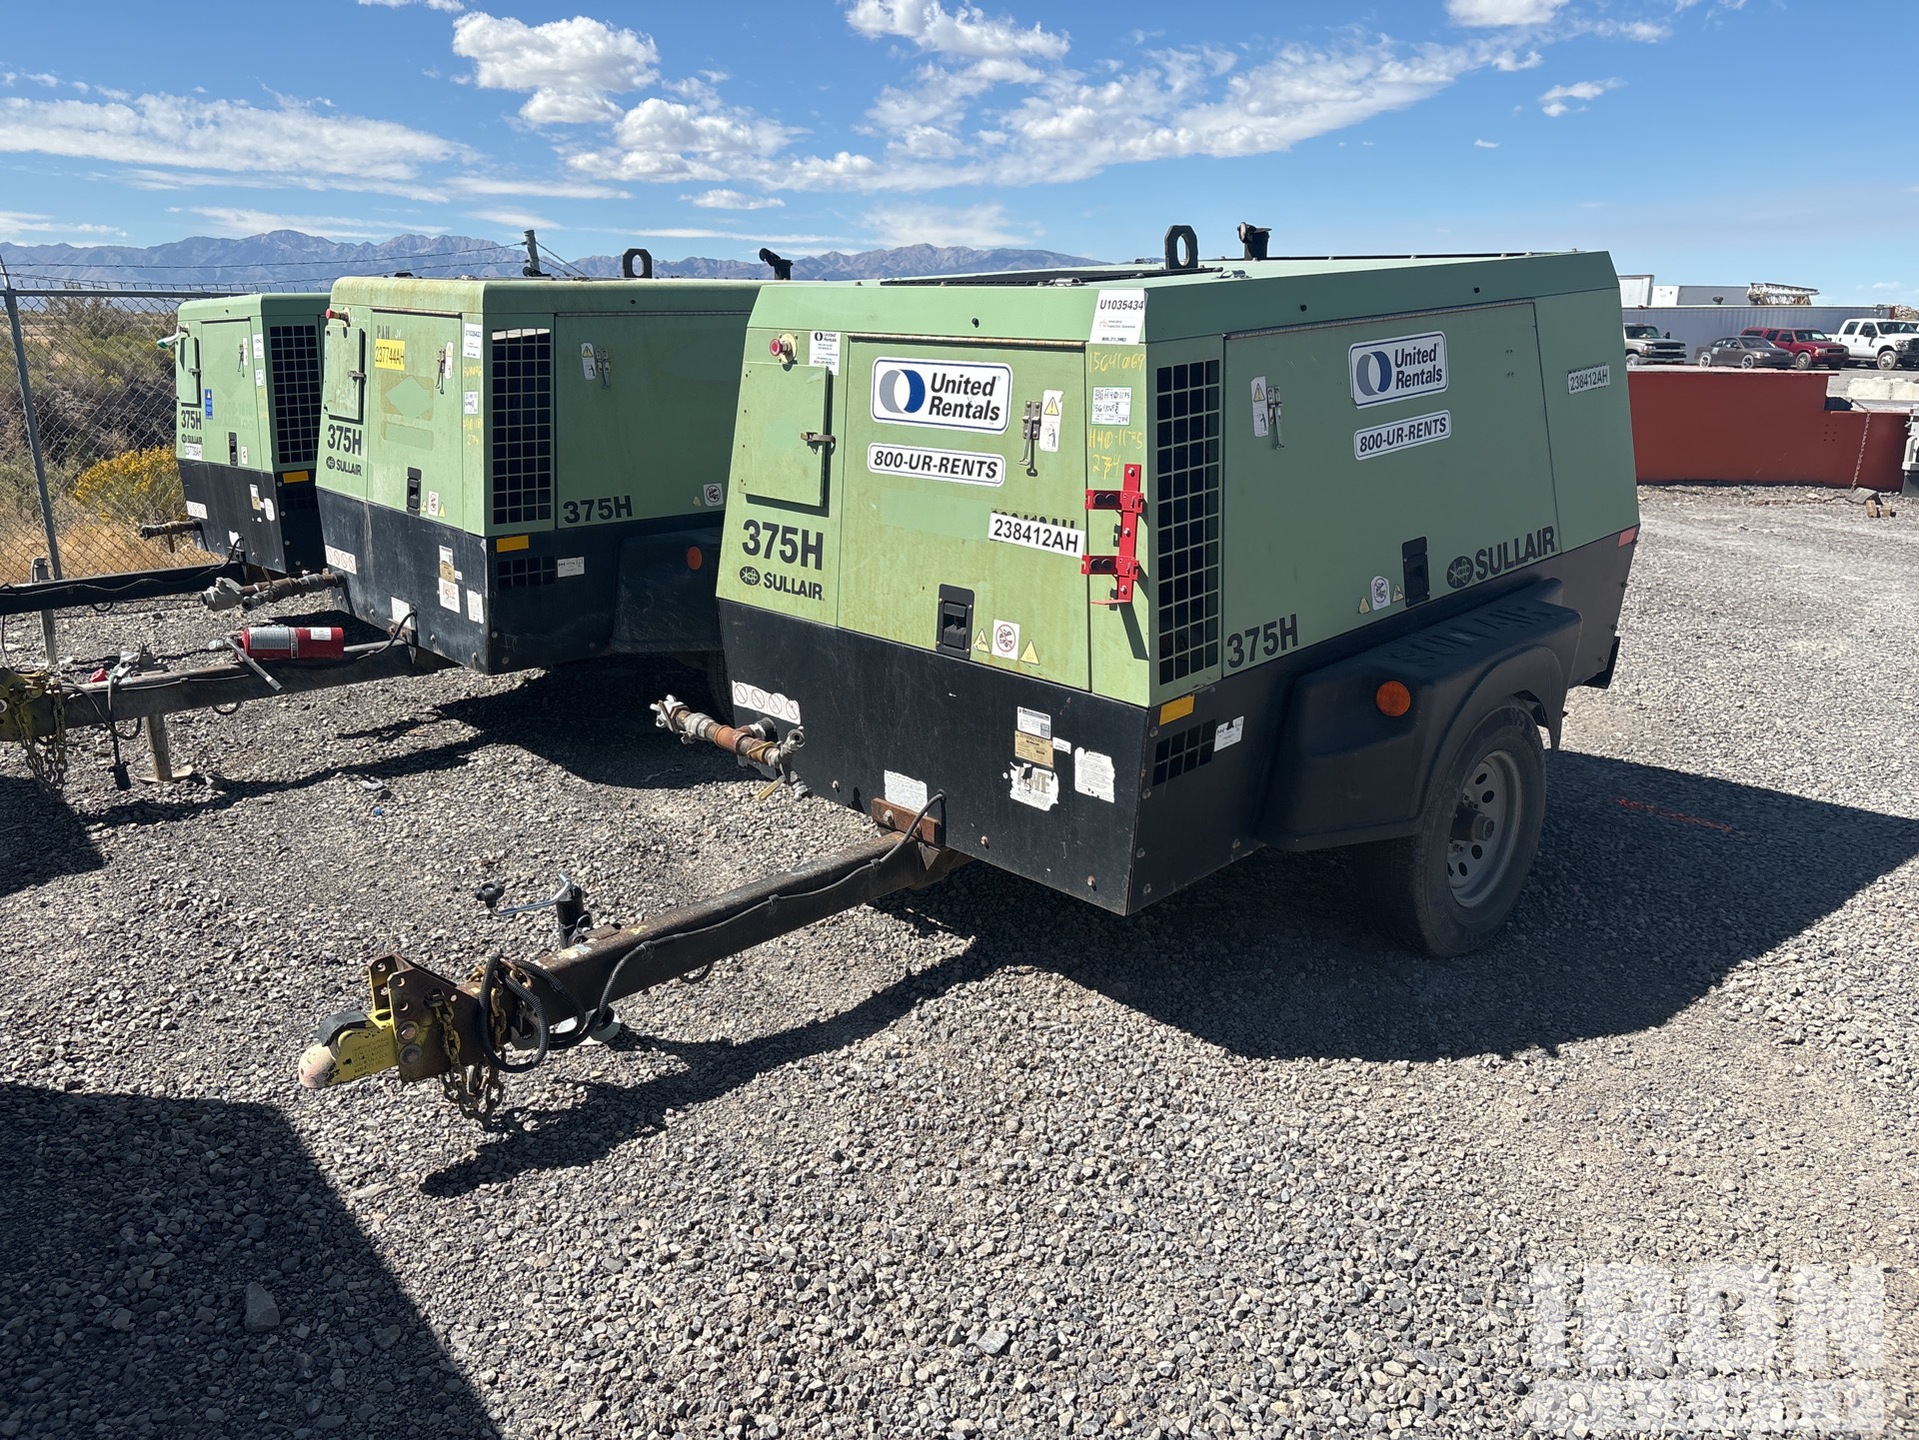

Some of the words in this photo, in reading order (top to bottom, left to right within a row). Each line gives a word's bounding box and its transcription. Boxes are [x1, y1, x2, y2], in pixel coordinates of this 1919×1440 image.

[1100, 299, 1144, 311] U1035434
[1395, 343, 1438, 370] United
[930, 372, 996, 397] United
[1396, 364, 1443, 390] Rentals
[1569, 368, 1608, 391] 238412AH
[181, 410, 202, 430] 375H
[929, 395, 1001, 423] Rentals
[327, 423, 362, 456] 375H
[1360, 417, 1447, 453] 800-UR-RENTS
[336, 458, 362, 477] SULLAIR
[874, 449, 998, 480] 800-UR-RENTS
[563, 495, 633, 524] 375H
[742, 520, 824, 570] 375H
[994, 518, 1078, 553] 238412AH
[1476, 527, 1556, 581] SULLAIR
[763, 572, 823, 600] SULLAIR
[1227, 613, 1298, 668] 375H
